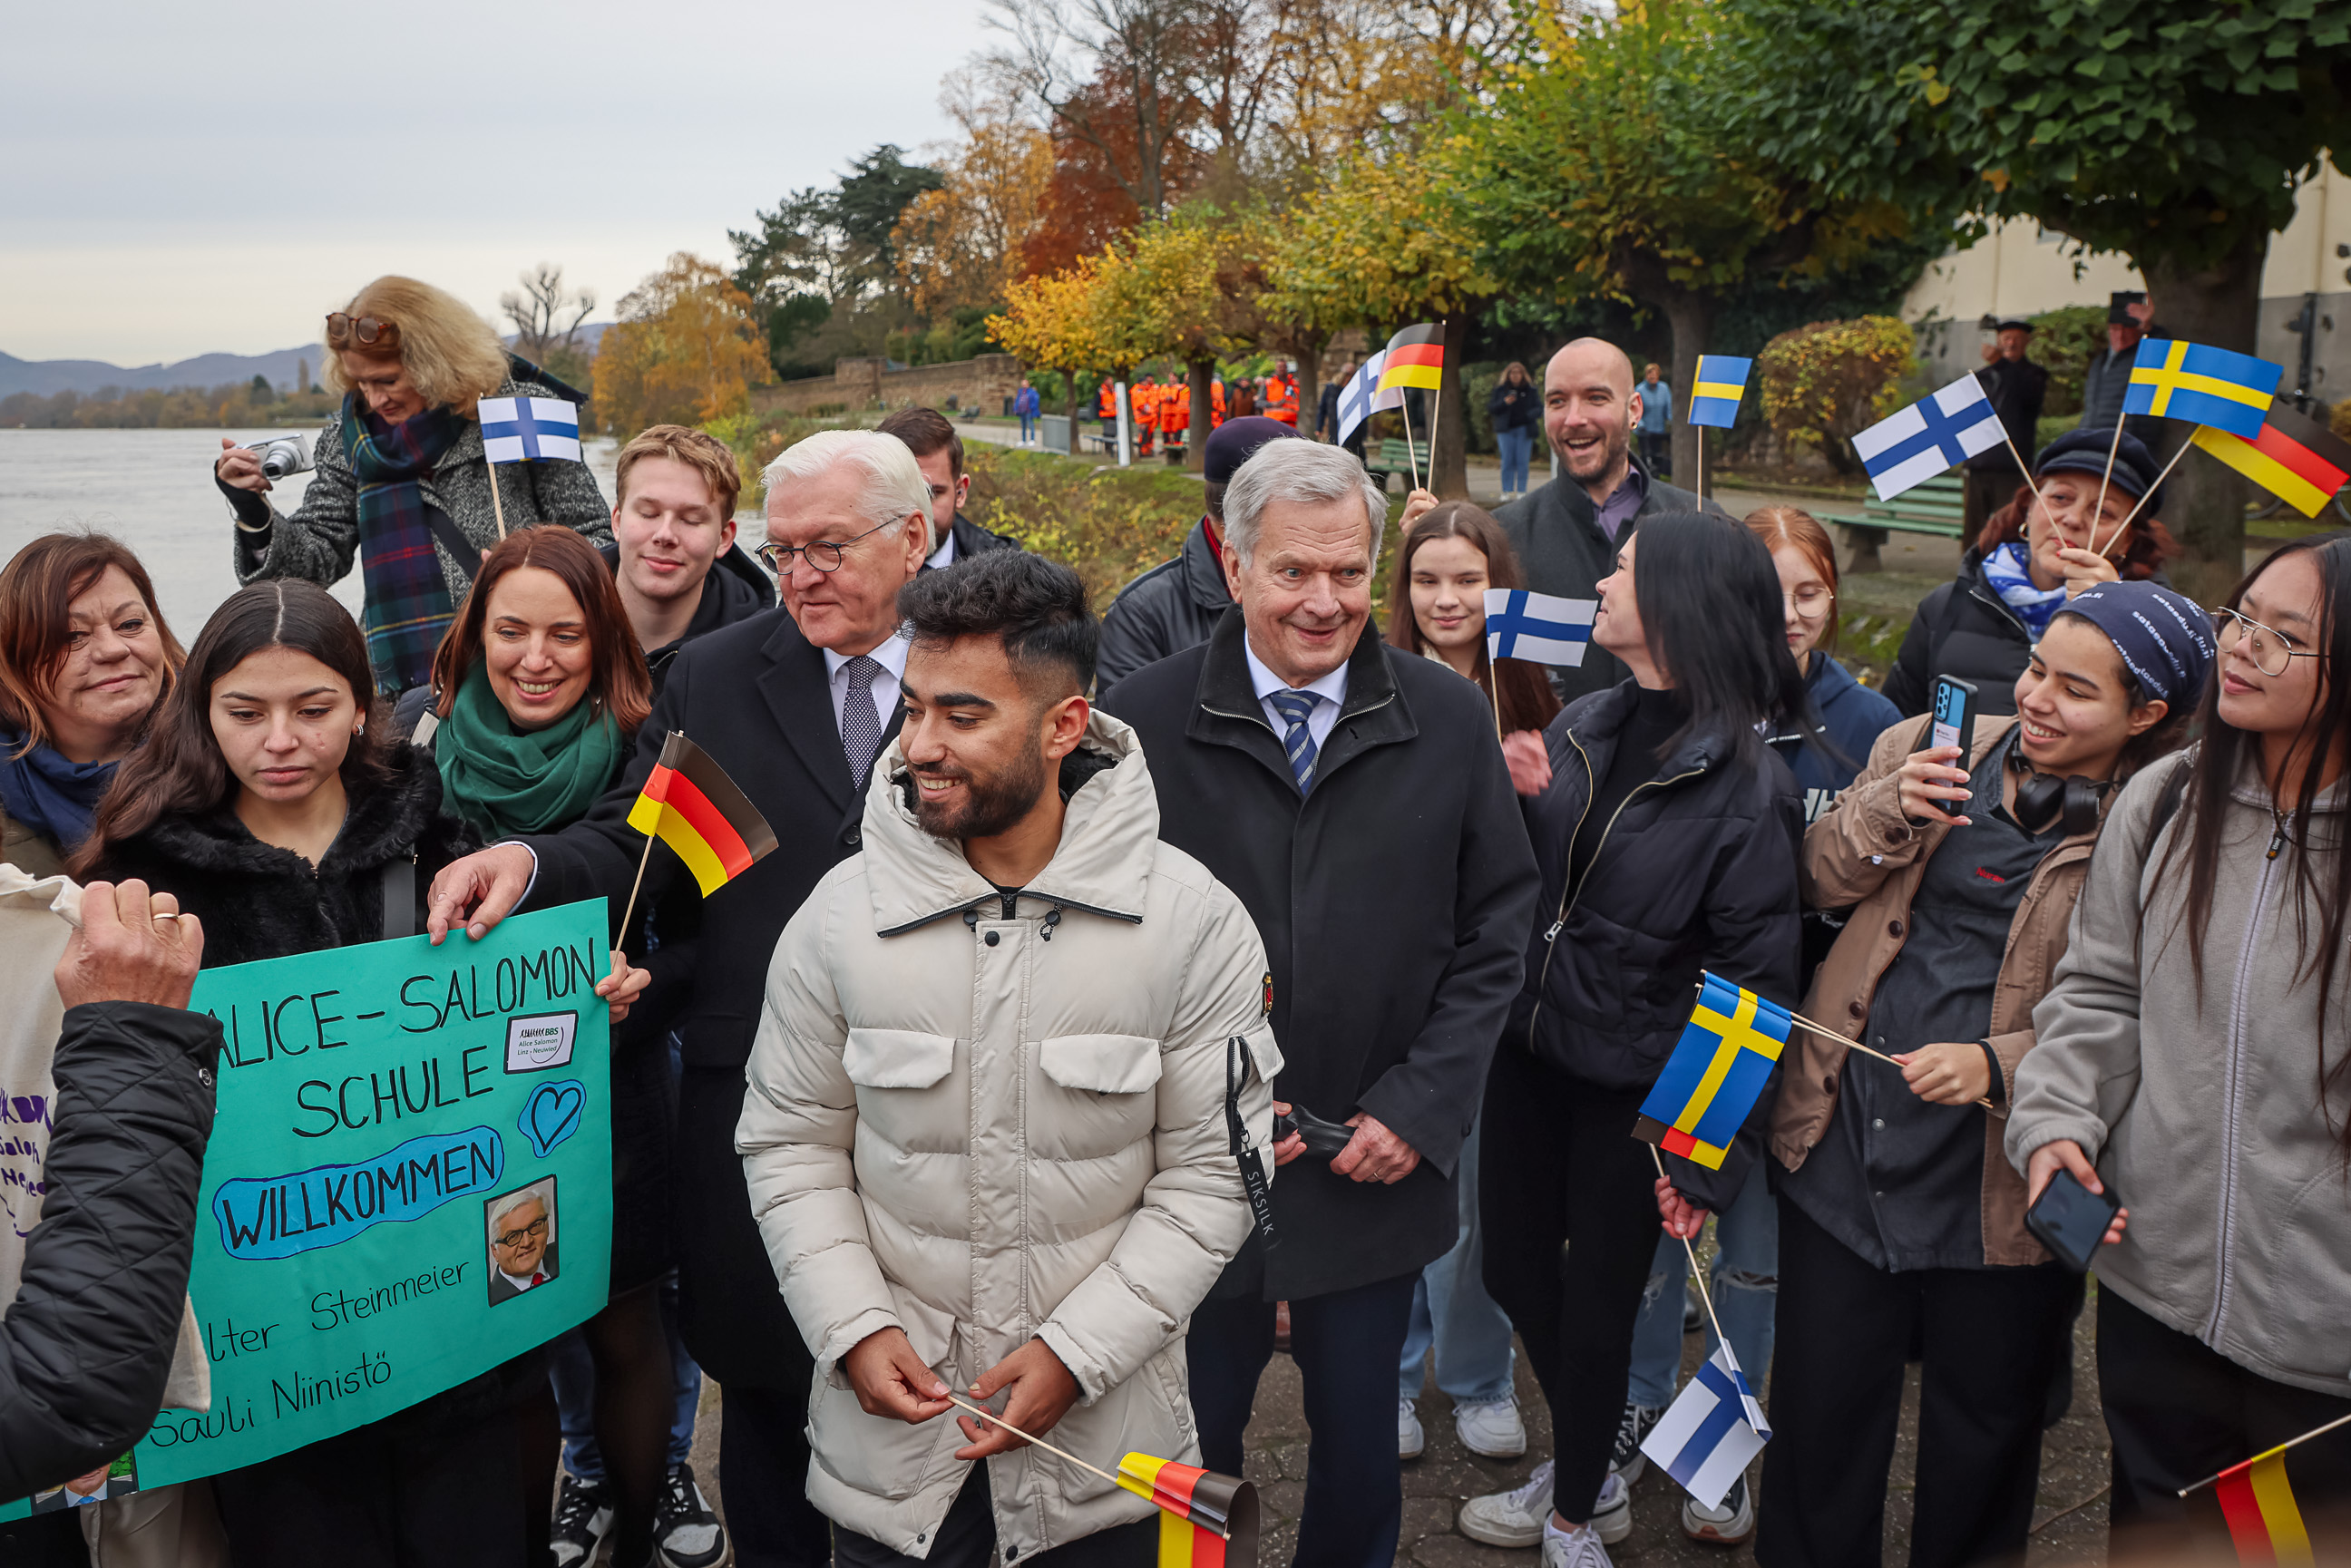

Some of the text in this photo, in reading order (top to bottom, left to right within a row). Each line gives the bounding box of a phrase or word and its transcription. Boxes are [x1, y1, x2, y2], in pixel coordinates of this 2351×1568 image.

[532, 1045, 558, 1054] Neuwied
[534, 1037, 558, 1046] Salomon
[544, 1027, 559, 1037] BBS
[291, 1045, 494, 1137] SCHULE
[222, 1136, 496, 1250] WILLKOMMEN
[1247, 1171, 1274, 1236] SIKSILK
[208, 1261, 470, 1362] lter Steinmeier
[149, 1349, 392, 1447] Sauli Niinistö
